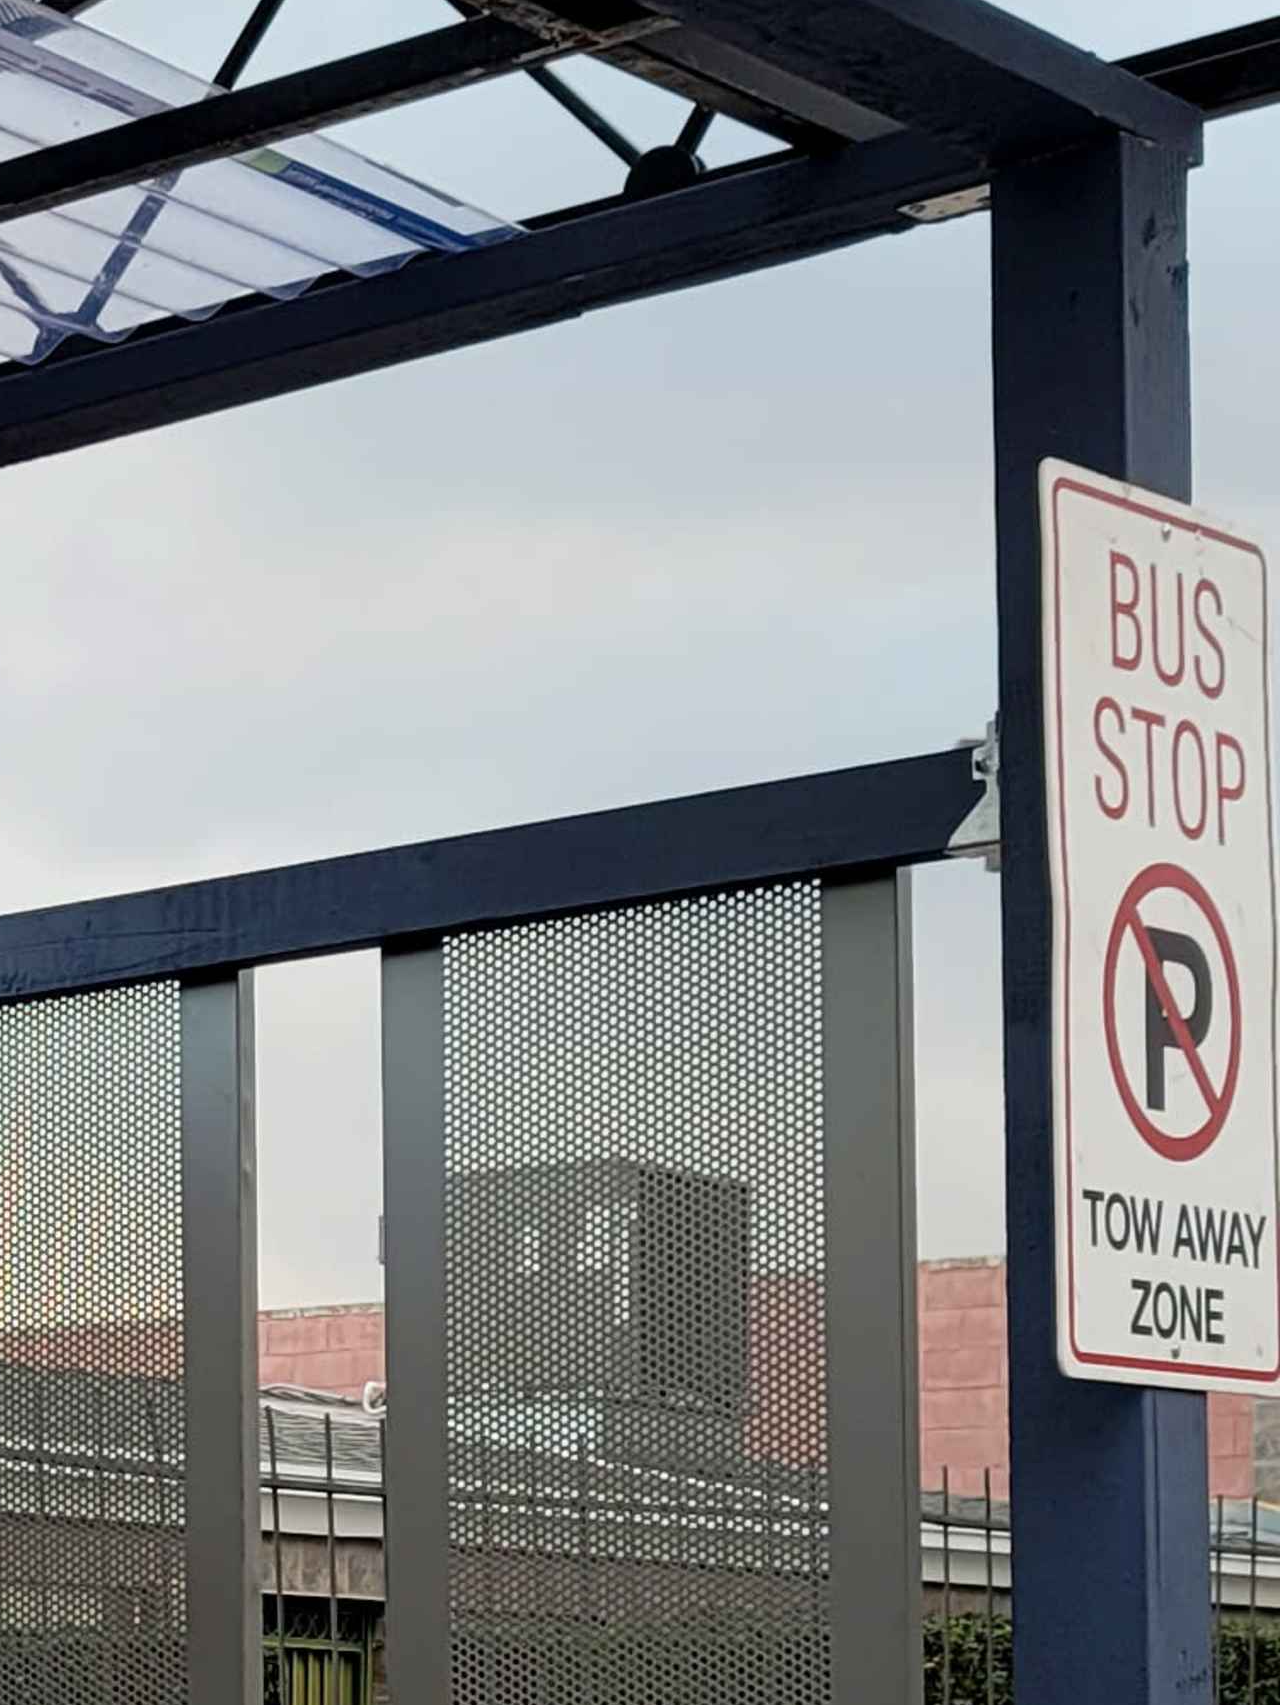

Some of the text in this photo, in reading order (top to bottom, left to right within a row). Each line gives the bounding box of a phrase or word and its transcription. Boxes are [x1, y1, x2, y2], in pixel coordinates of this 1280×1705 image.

[1109, 549, 1226, 700] BUS
[1093, 696, 1246, 846] STOP
[1082, 1189, 1267, 1270] TOW AWAY
[1130, 1278, 1225, 1344] ZONE
